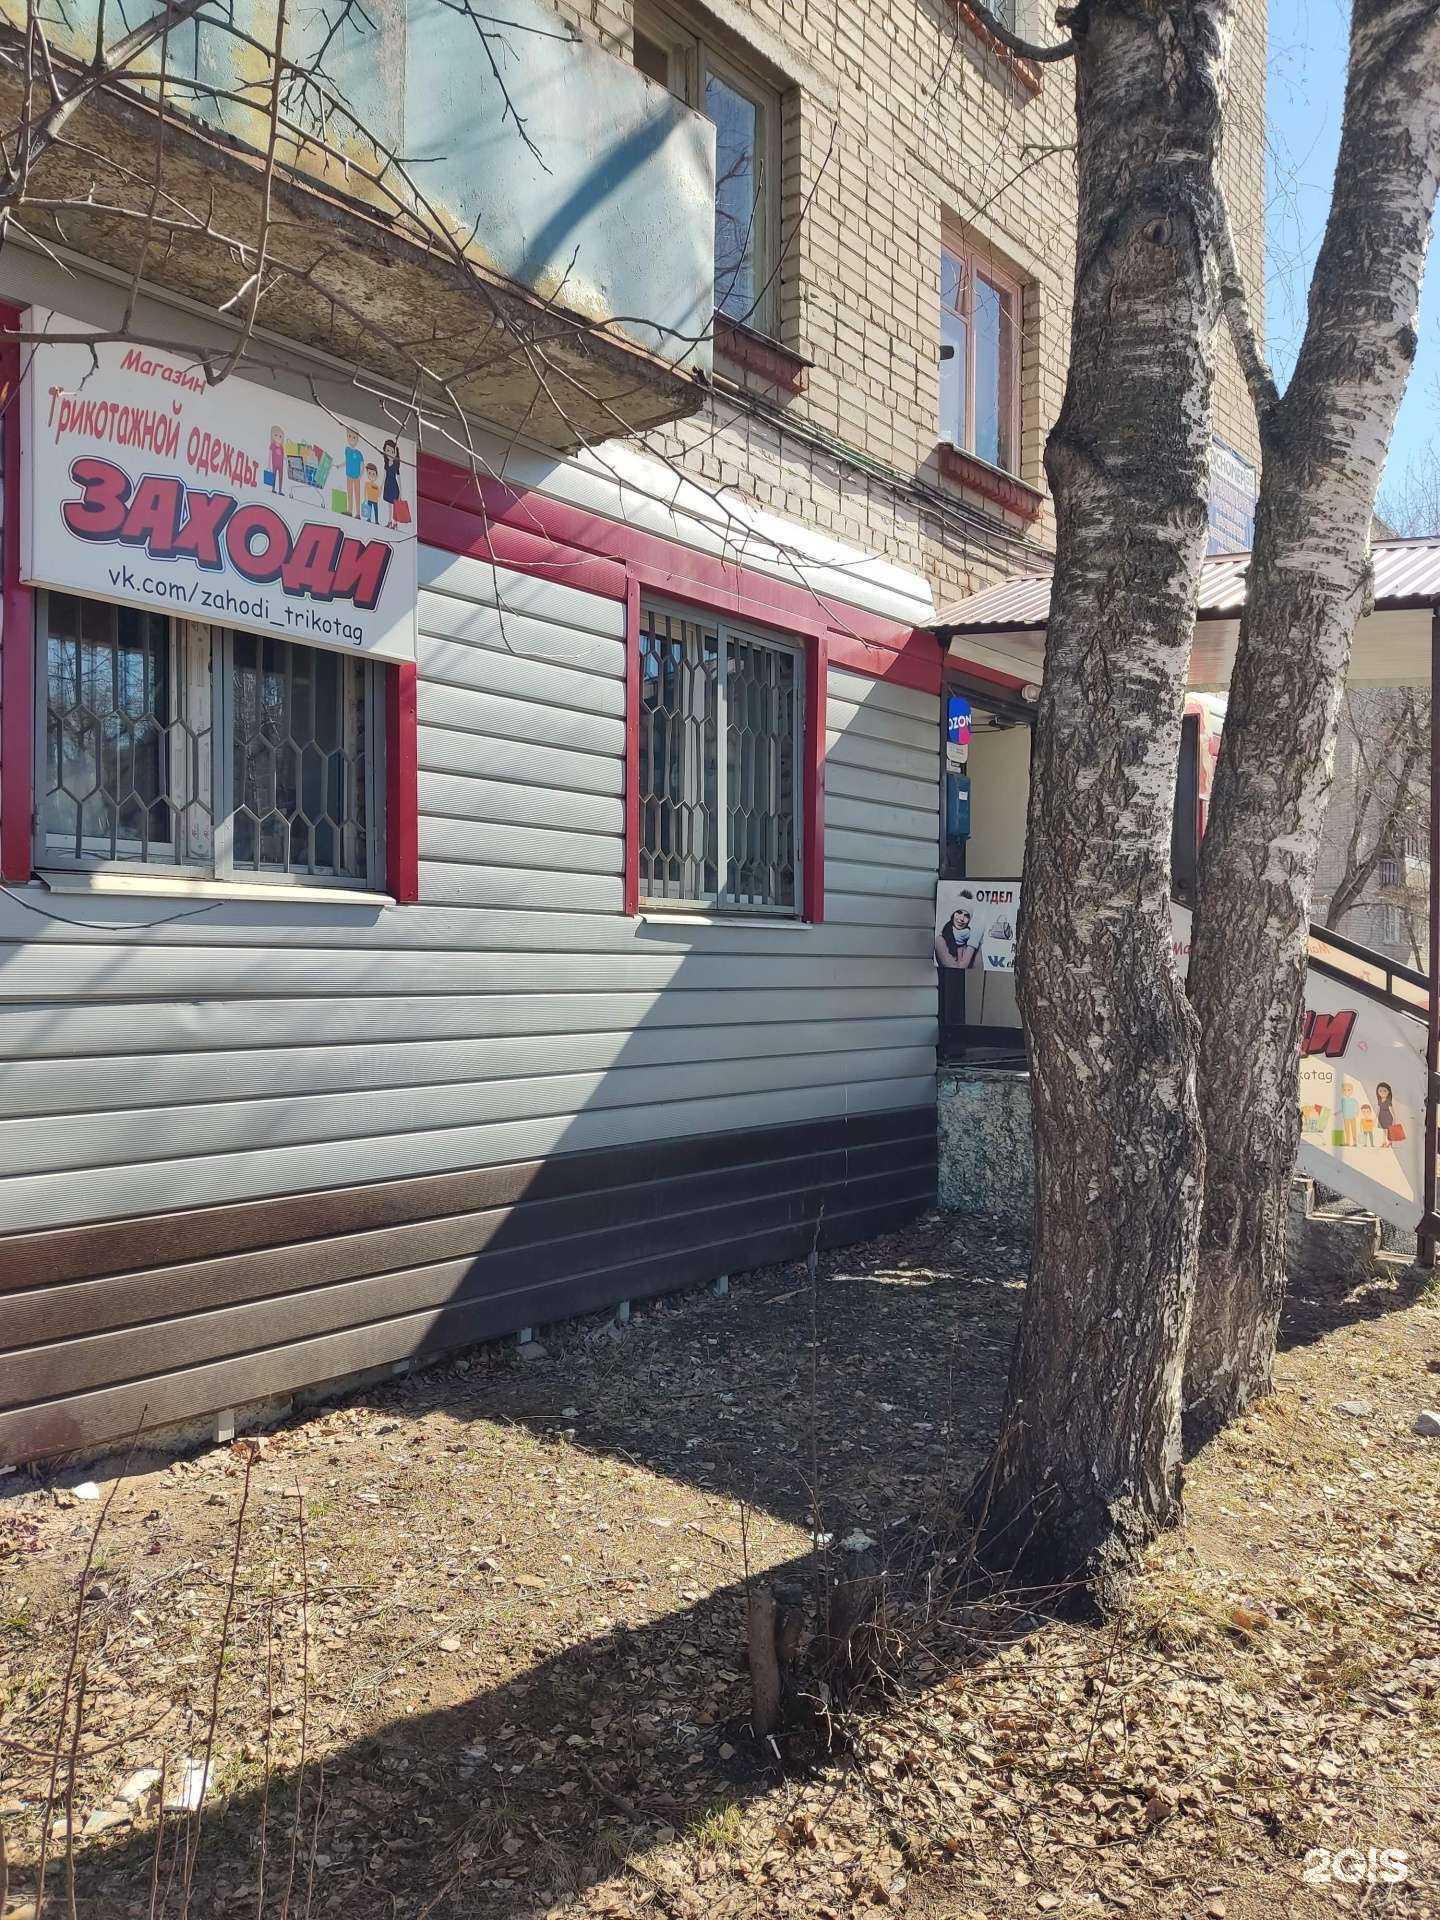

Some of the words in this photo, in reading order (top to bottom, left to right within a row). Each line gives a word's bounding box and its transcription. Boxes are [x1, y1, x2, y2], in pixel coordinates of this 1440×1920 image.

[120, 349, 206, 395] Магазин
[48, 385, 182, 460] Трикотажной
[186, 426, 260, 488] одежды
[62, 456, 392, 610] ЗАХОДИ
[108, 567, 364, 646] vk.com/zahodi_trikotag
[976, 890, 1013, 904] ОТДЕЛ
